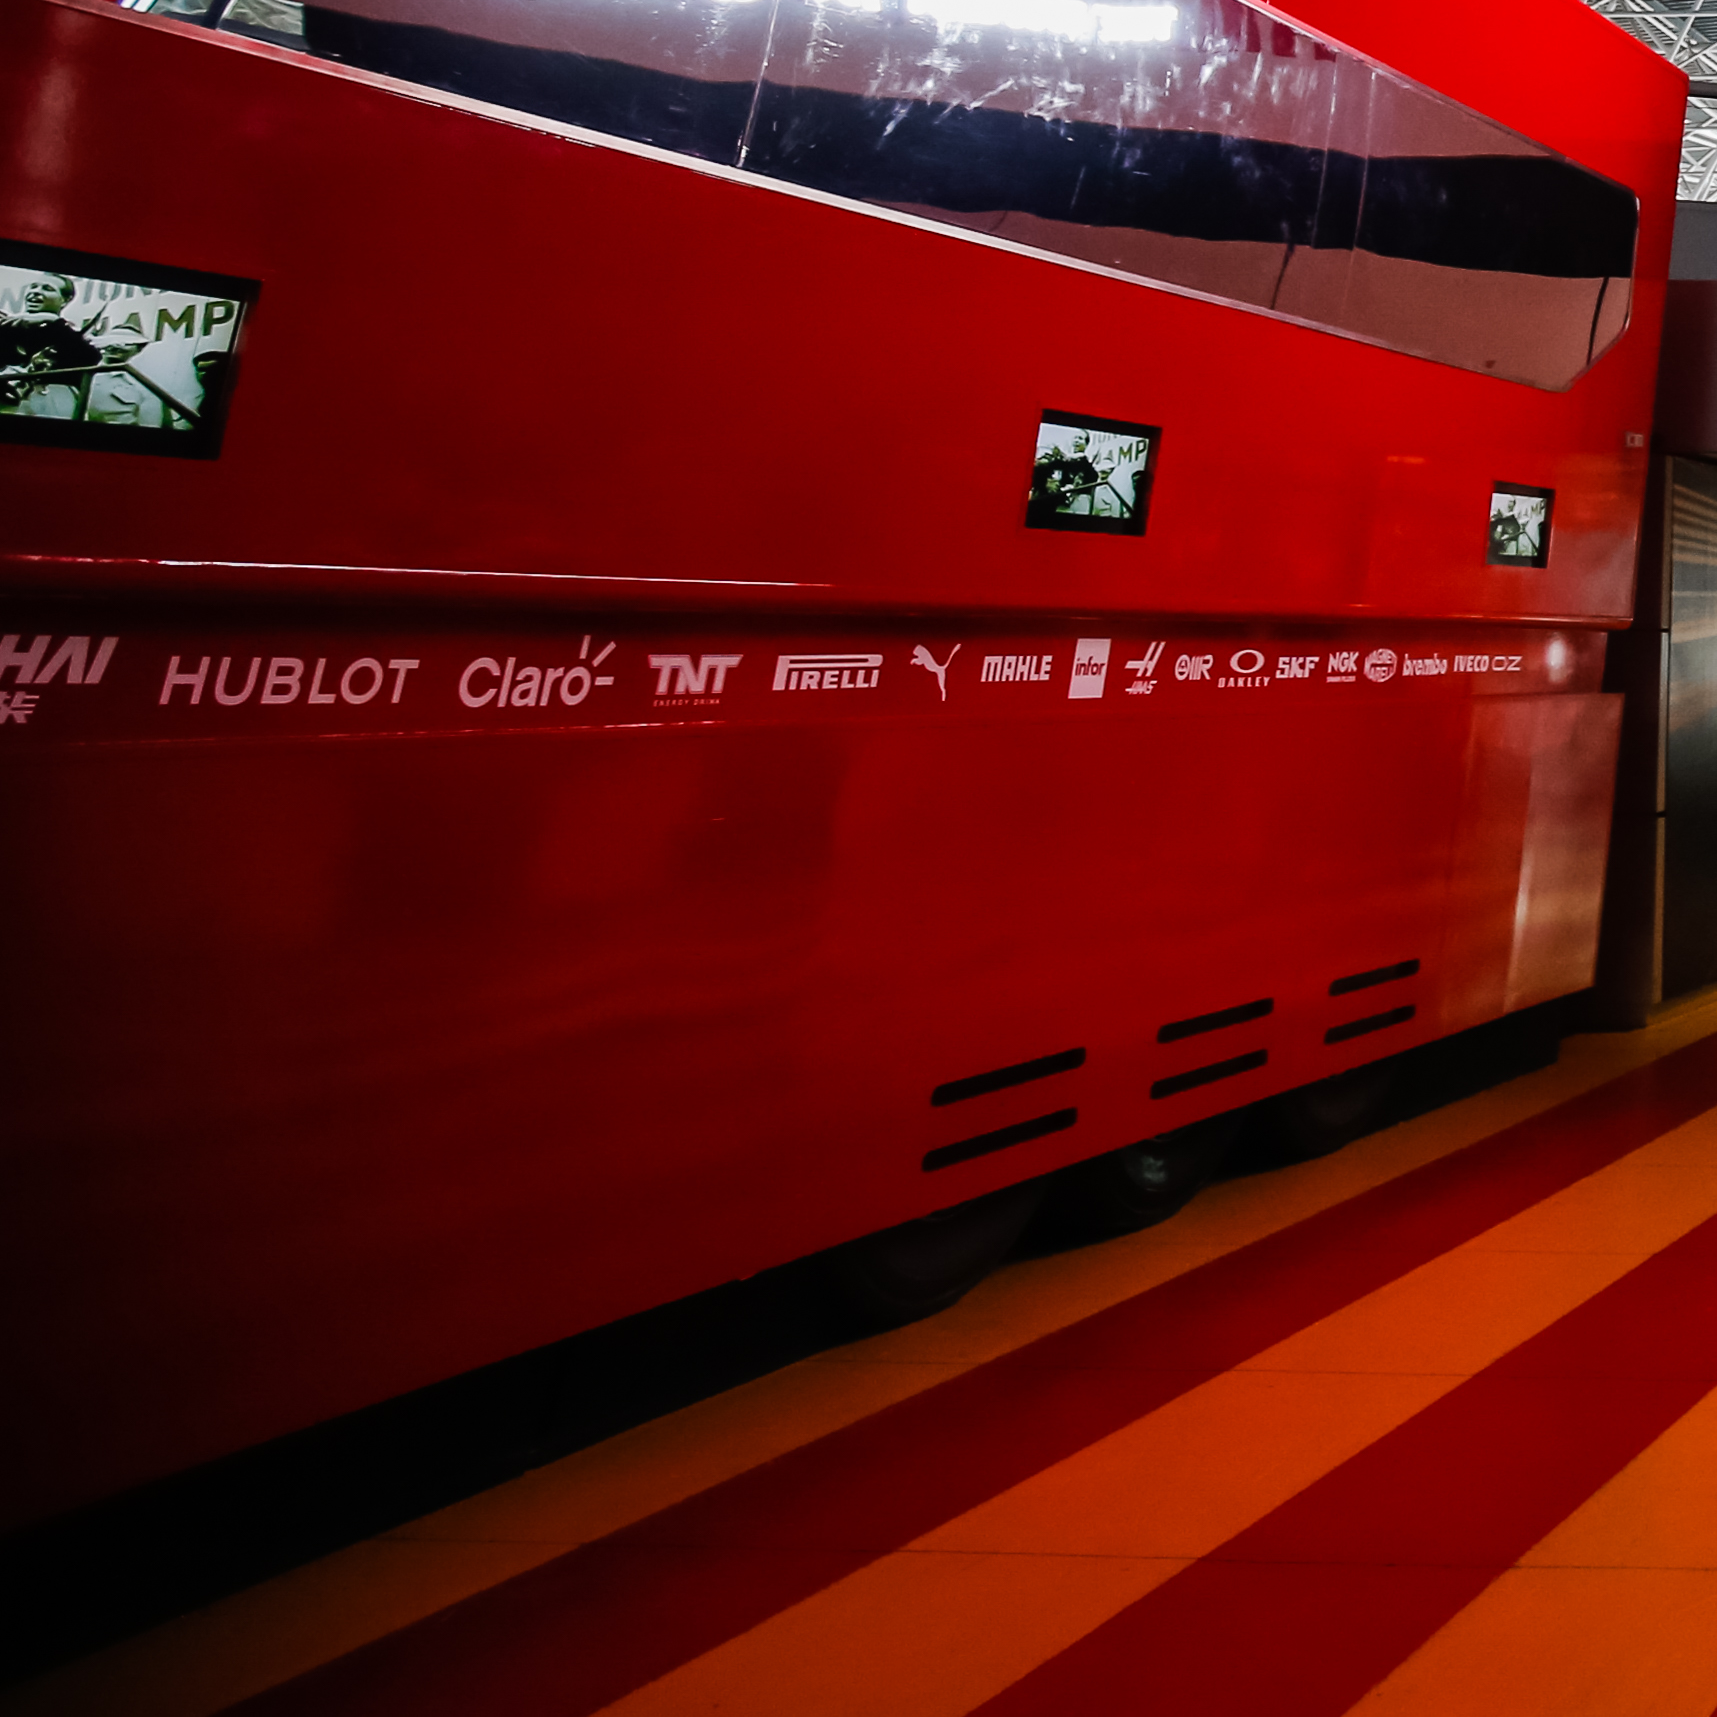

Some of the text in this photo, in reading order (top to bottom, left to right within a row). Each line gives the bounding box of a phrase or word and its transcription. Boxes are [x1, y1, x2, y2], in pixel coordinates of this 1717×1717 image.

[772, 654, 883, 691] PIRELLI
[980, 655, 1053, 682] MAHLE
[1074, 656, 1106, 676] infor
[1275, 656, 1320, 679] SKF
[1327, 651, 1359, 673] NGK
[1402, 653, 1448, 676] brembo
[1453, 654, 1490, 673] IVECO
[1491, 655, 1523, 672] OZ
[159, 655, 421, 706] HUBLOT
[457, 656, 592, 707] Claro
[649, 654, 743, 694] TNT
[1217, 676, 1270, 688] OAKLEY
